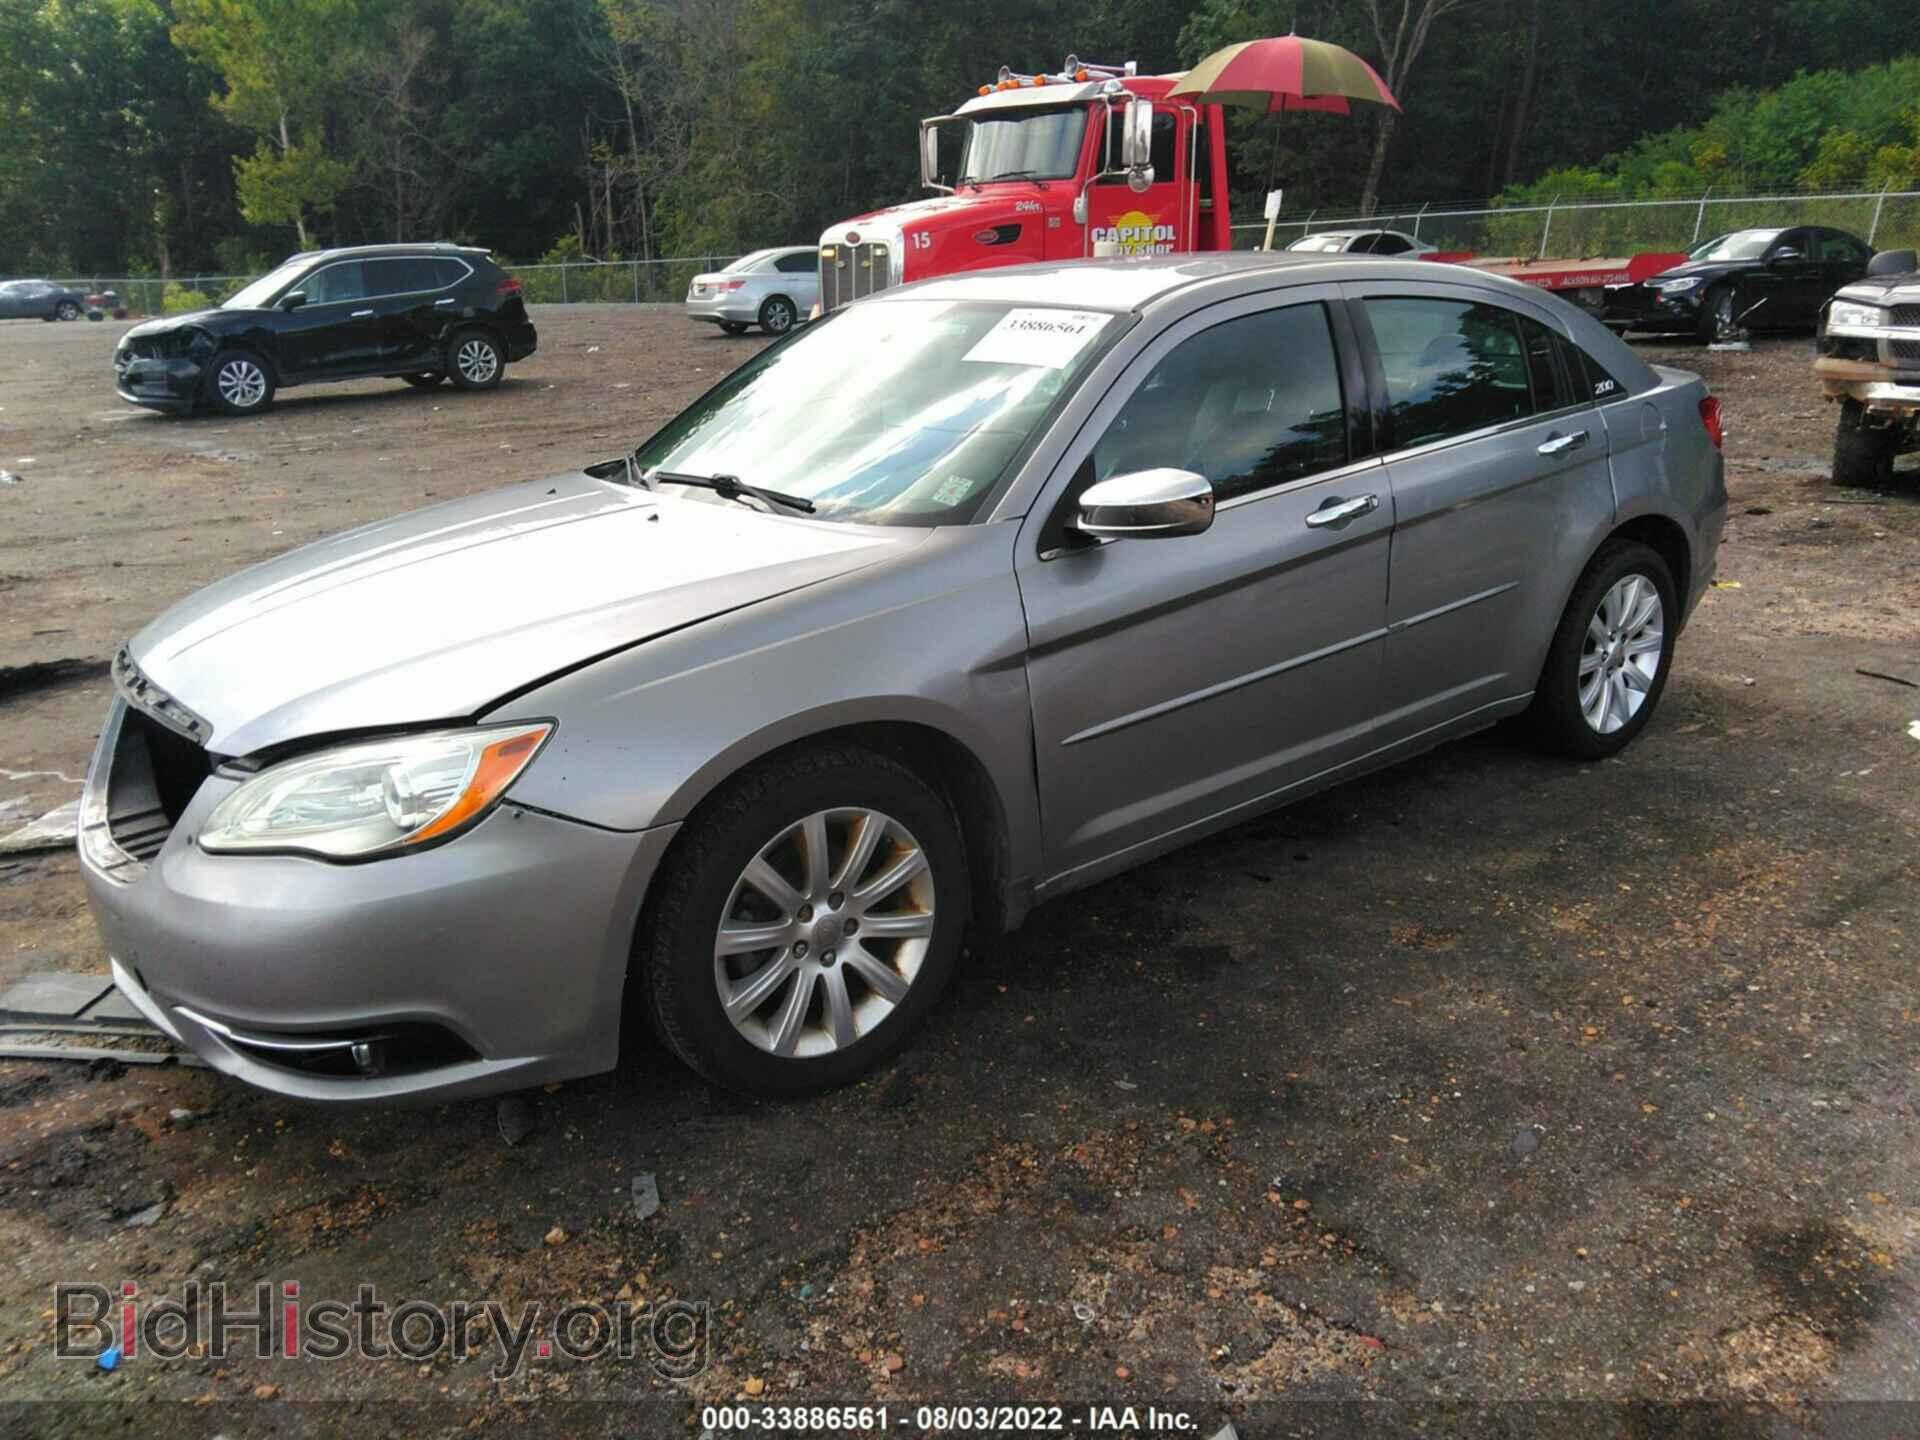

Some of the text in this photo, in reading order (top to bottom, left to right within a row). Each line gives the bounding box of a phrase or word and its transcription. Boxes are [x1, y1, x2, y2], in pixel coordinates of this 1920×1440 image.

[912, 232, 931, 248] 15
[1091, 225, 1176, 243] CAPITOL
[1594, 379, 1615, 395] 200
